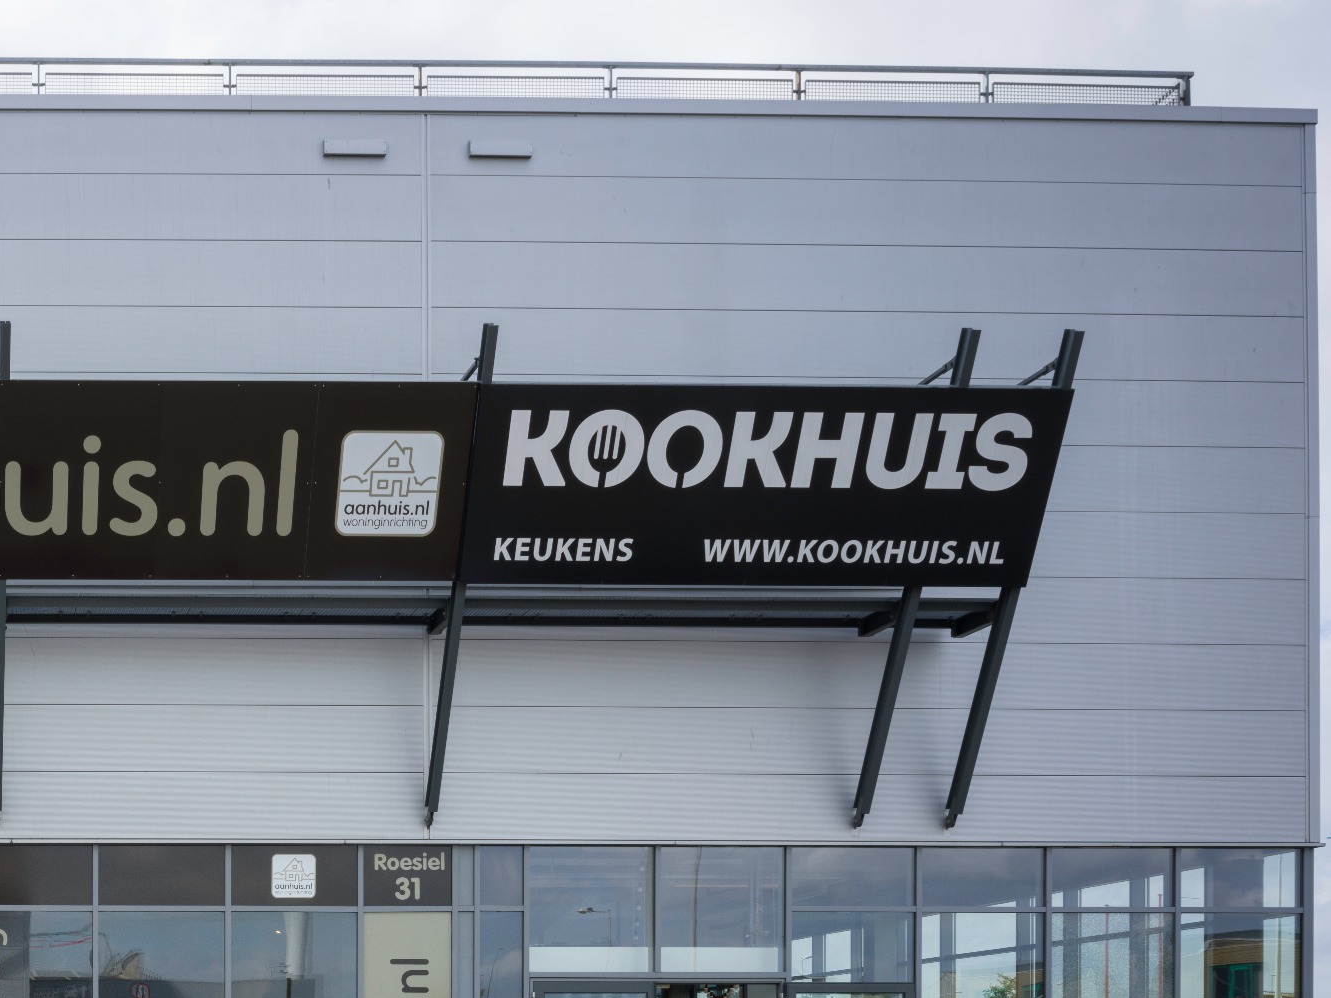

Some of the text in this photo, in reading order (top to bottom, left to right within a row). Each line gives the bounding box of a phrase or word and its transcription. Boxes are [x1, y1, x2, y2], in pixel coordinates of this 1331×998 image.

[502, 408, 1034, 492] KOOKHUIS
[343, 499, 430, 516] aanhuis.nl
[342, 517, 428, 530] woninginrichting
[493, 537, 634, 562] KEUKENS
[703, 538, 1005, 565] WWW.KOOKHUIS.NL
[373, 851, 445, 871] Roesiel
[394, 876, 421, 901] 31
